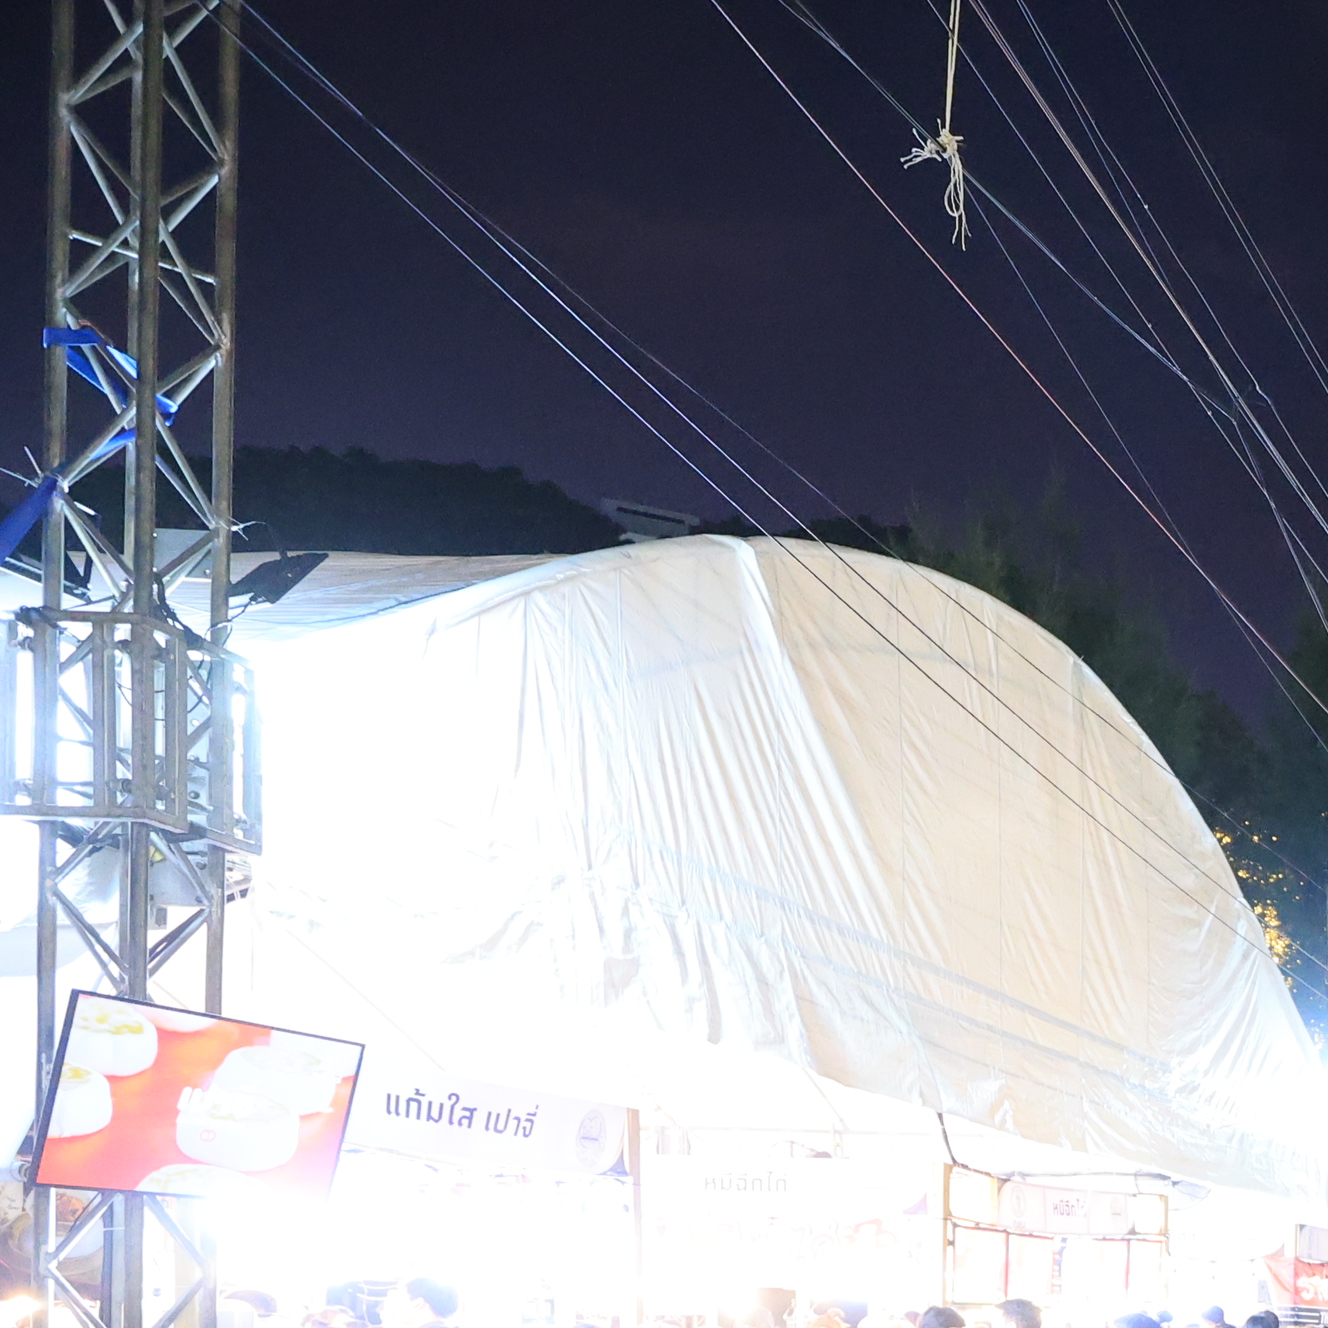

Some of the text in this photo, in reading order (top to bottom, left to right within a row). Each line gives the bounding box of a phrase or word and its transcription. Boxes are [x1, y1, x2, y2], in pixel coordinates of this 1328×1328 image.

[386, 1088, 477, 1129] แก้มใส
[484, 1104, 539, 1138] เปาจี่
[704, 1171, 787, 1192] หมีฉีกไก่
